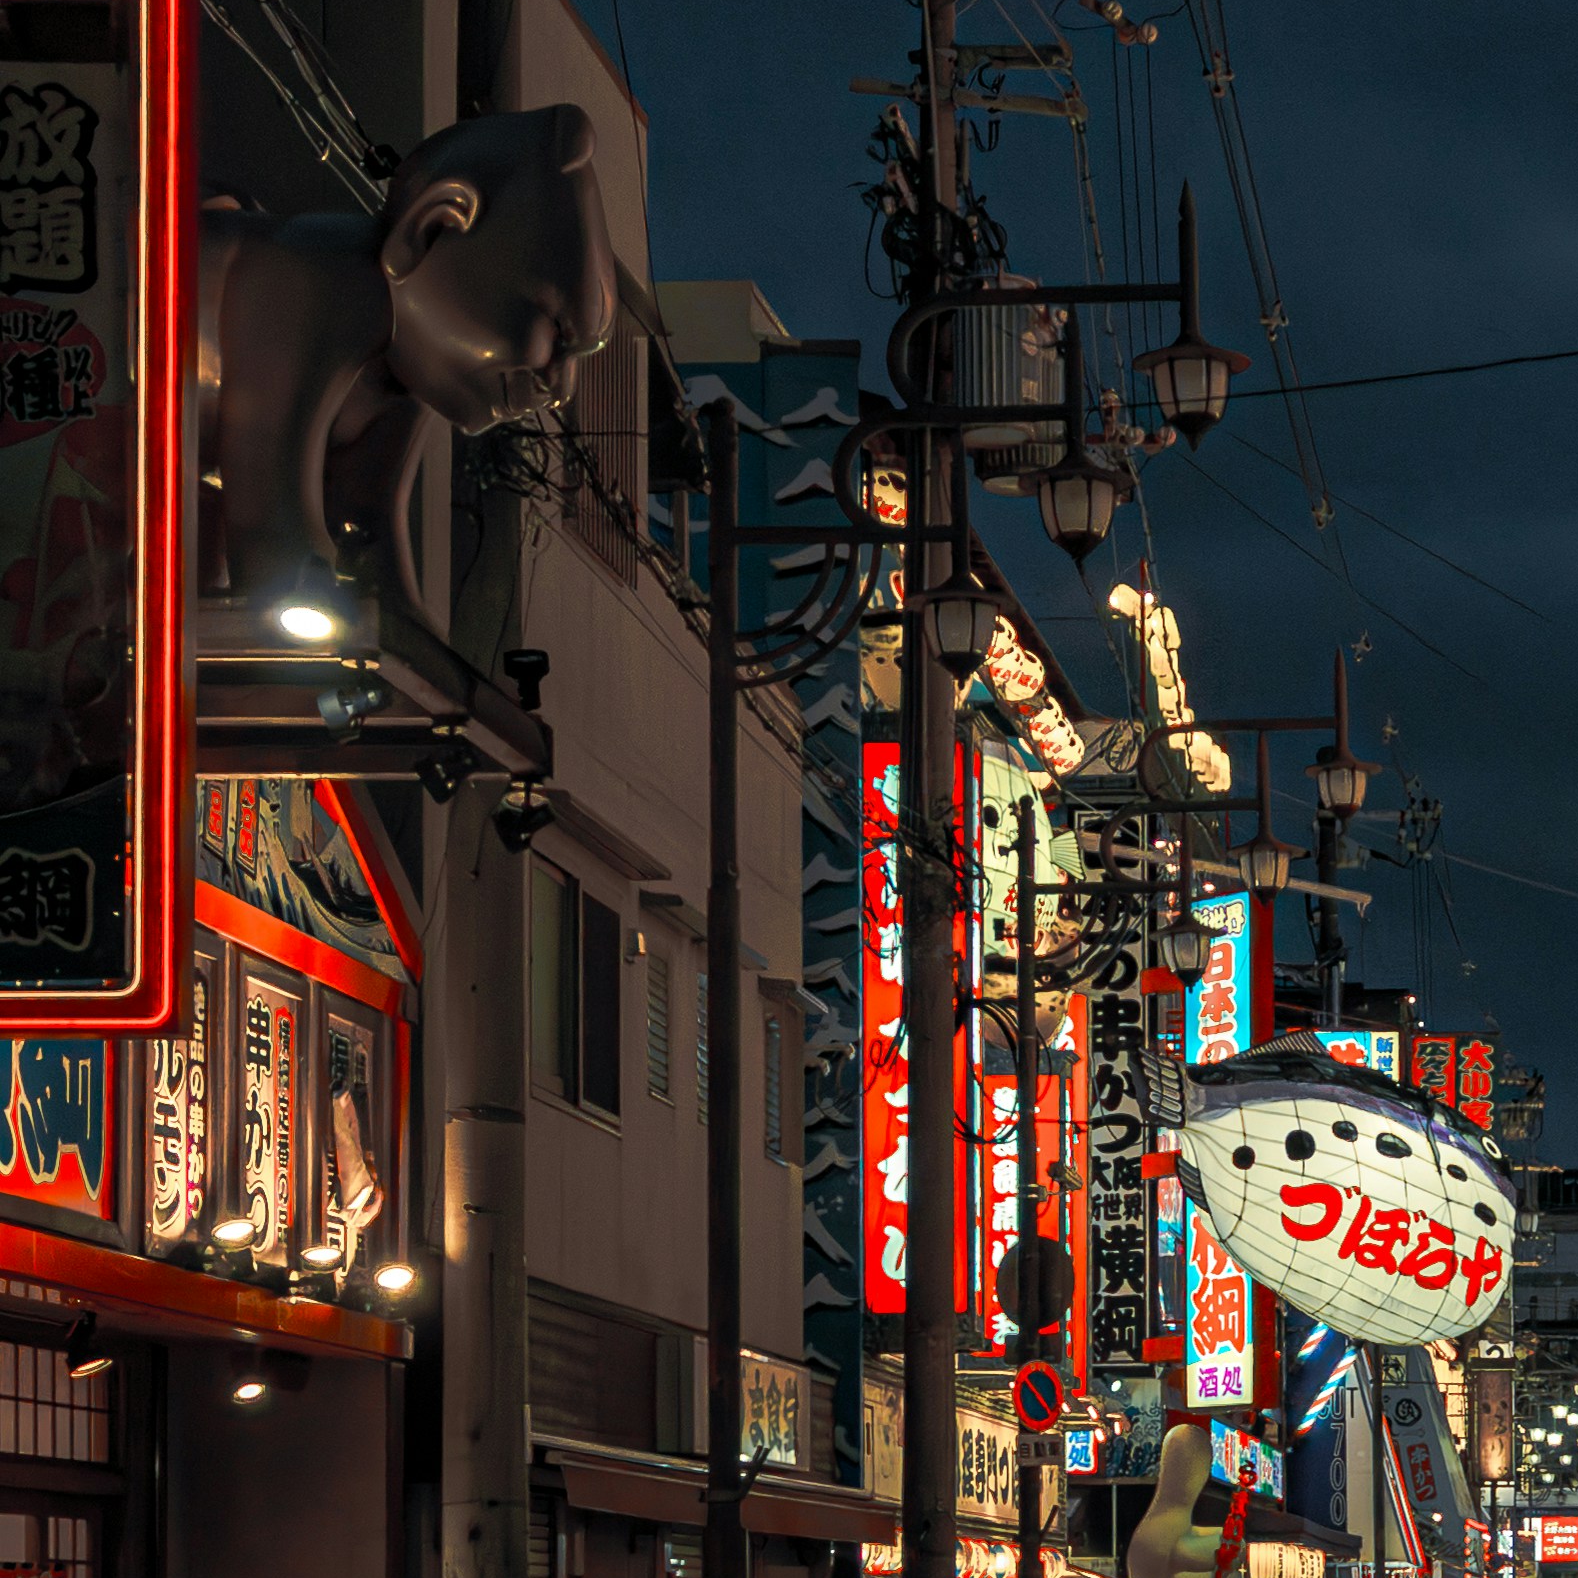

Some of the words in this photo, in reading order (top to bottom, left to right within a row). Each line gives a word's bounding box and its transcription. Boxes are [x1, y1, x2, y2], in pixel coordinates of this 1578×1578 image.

[1280, 1183, 1503, 1307] づぼらや
[1198, 1366, 1243, 1398] 酒処
